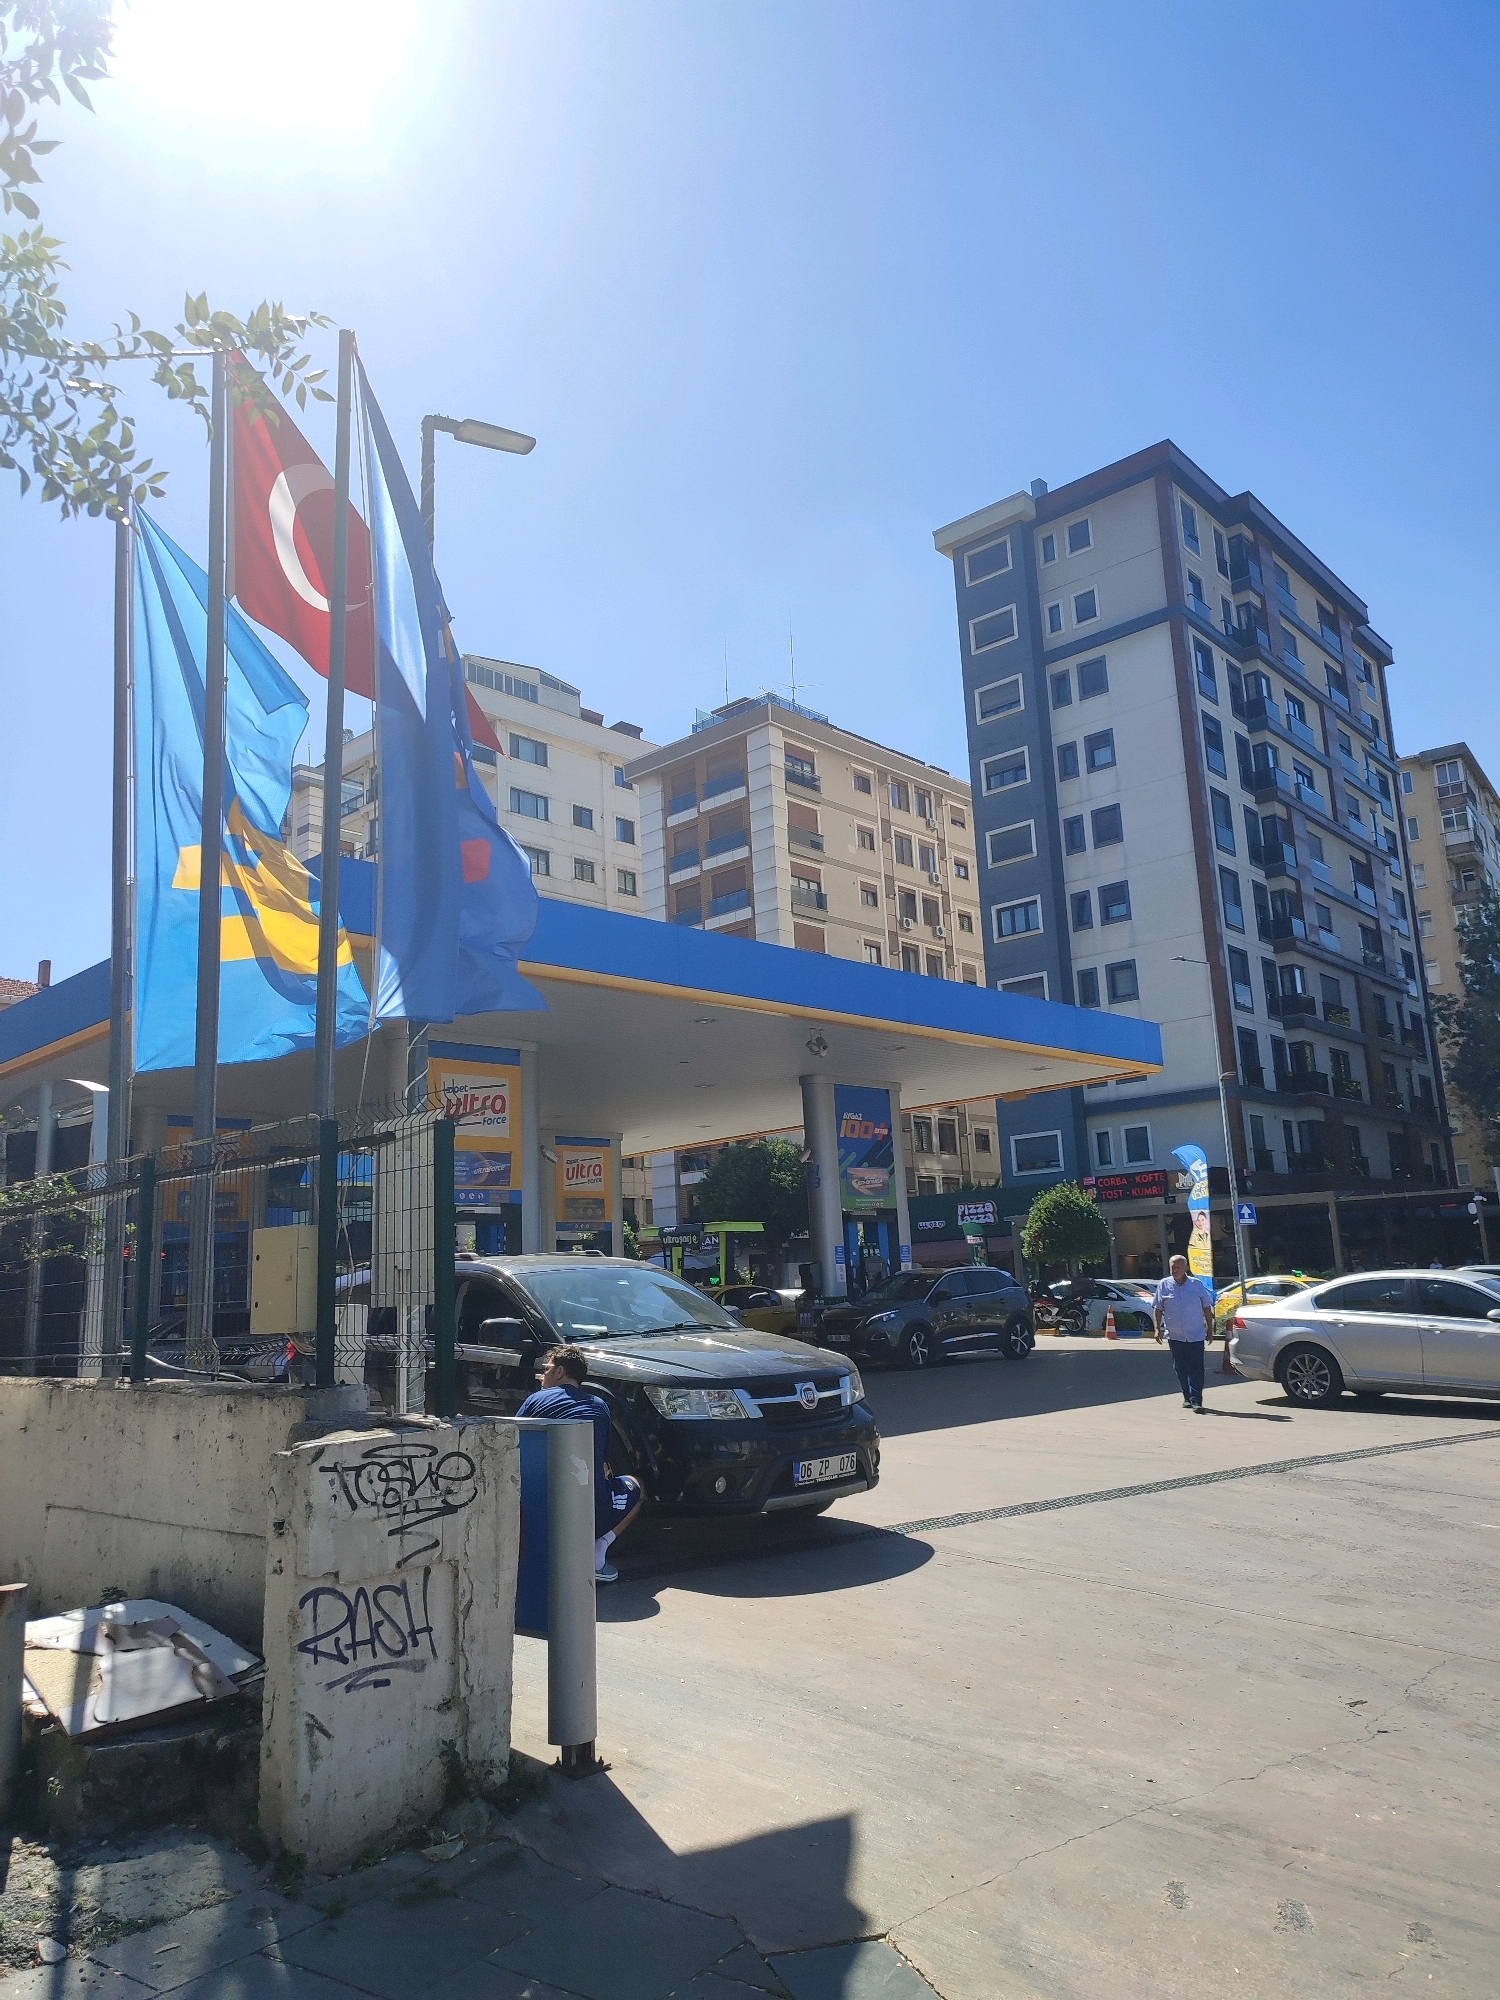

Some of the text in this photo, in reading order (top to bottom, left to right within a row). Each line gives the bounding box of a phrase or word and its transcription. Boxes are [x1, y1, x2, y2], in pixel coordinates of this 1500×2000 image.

[445, 1094, 507, 1118] ultra
[482, 1116, 507, 1126] force
[843, 1112, 863, 1120] AYGAZ
[565, 1163, 602, 1181] ultra
[1101, 1186, 1165, 1200] TOST KUMRU
[801, 1454, 855, 1479] 06 ZP 076
